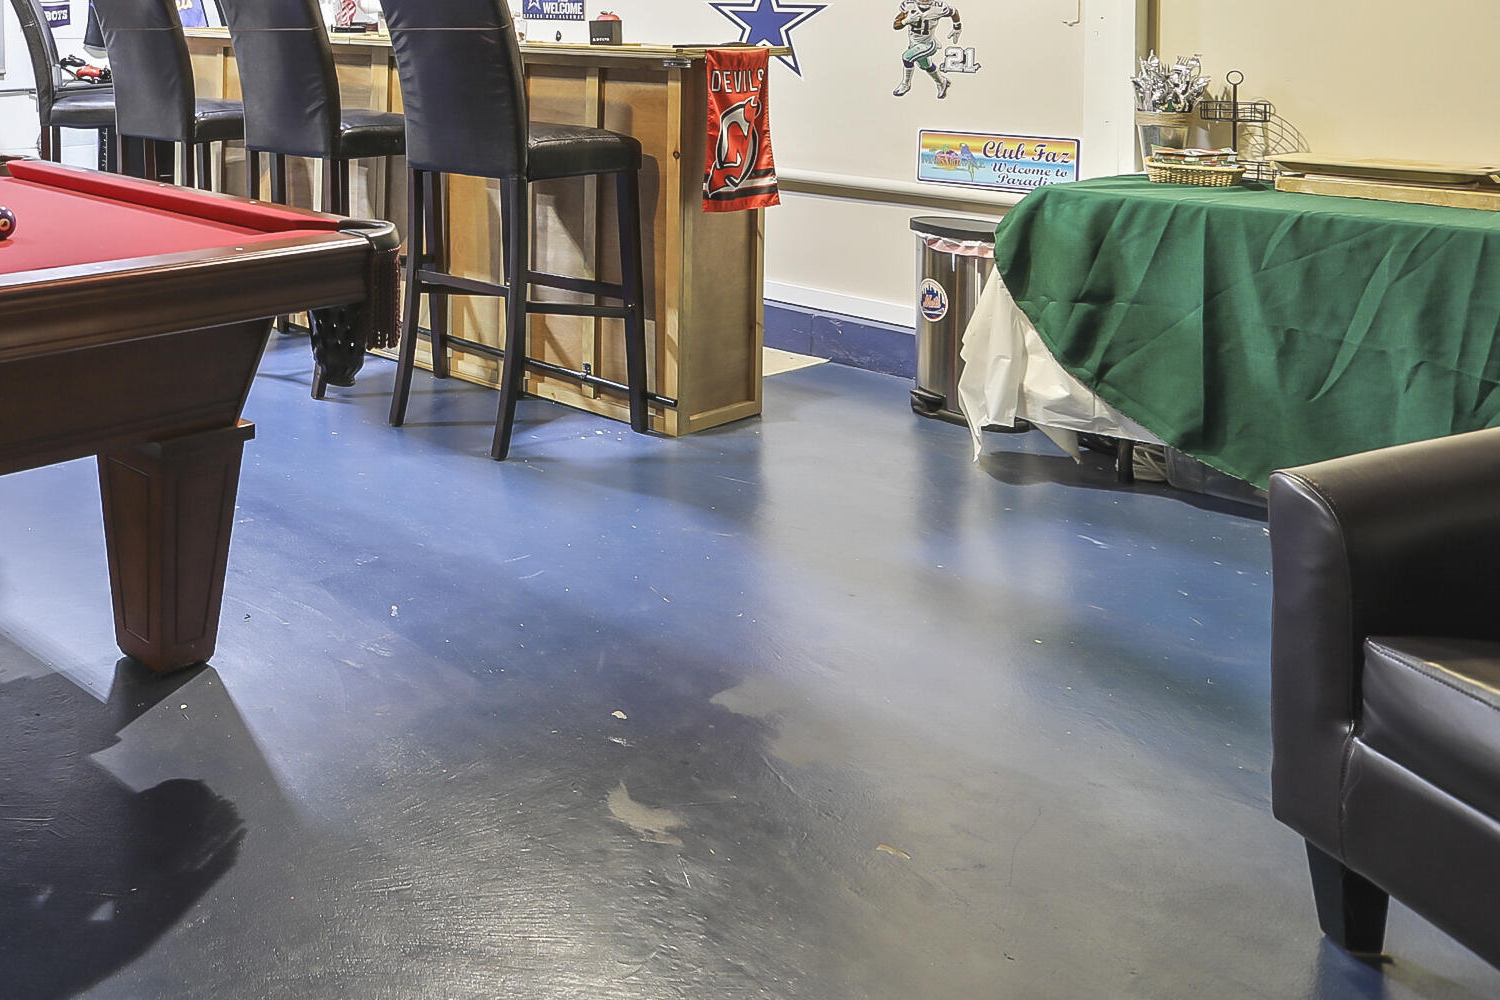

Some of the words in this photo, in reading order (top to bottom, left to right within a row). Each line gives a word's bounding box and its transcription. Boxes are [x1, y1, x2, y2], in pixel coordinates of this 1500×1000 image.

[542, 2, 583, 14] WELCOME
[944, 47, 976, 73] 21
[711, 68, 765, 93] DEVILS
[983, 140, 1026, 160] Club
[1031, 144, 1071, 164] Faz
[991, 162, 1051, 177] Welcome
[1054, 168, 1068, 178] to
